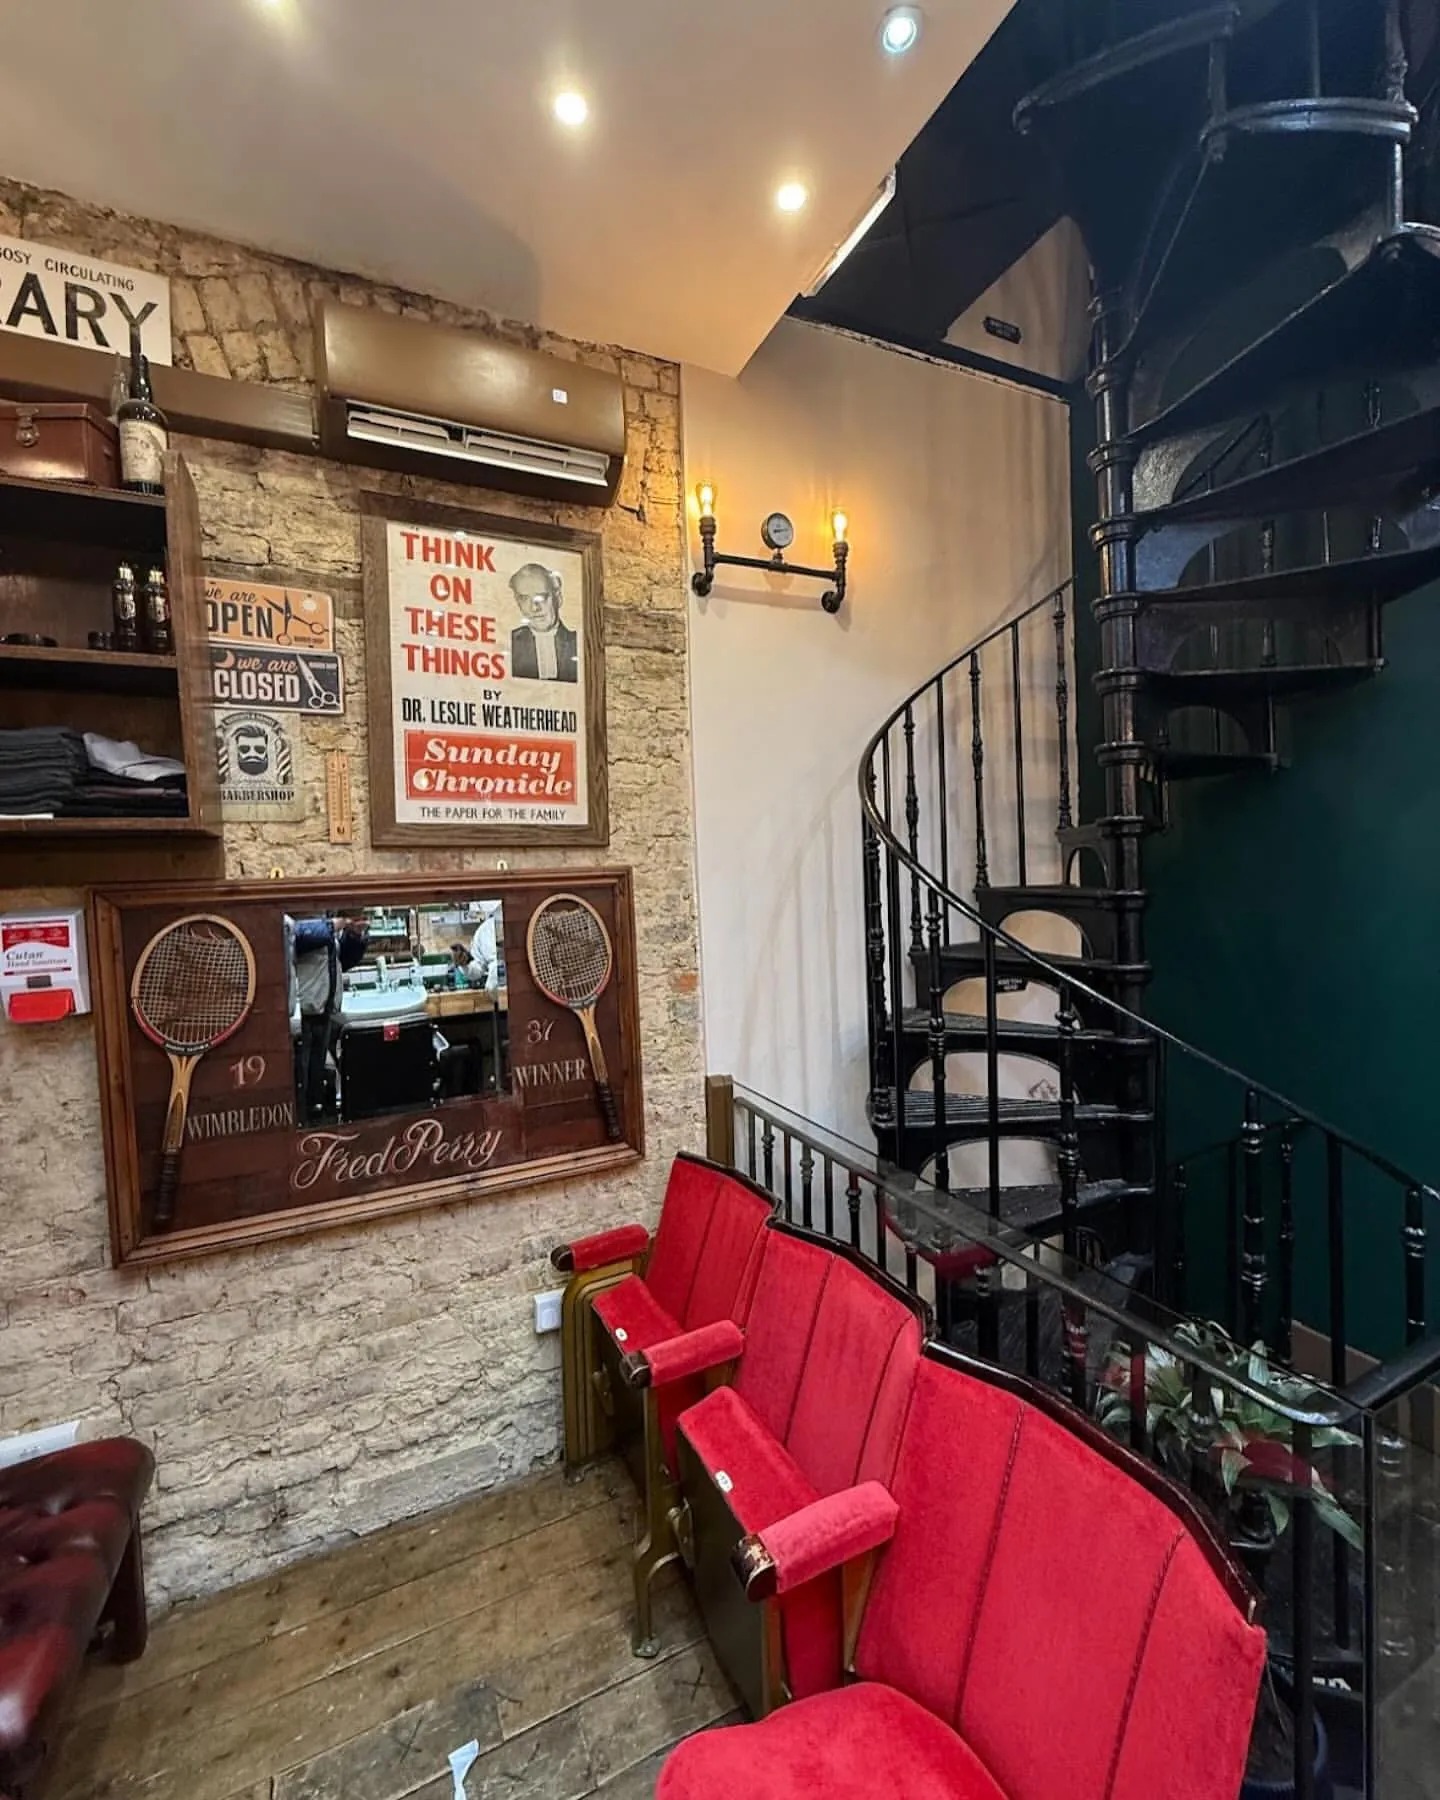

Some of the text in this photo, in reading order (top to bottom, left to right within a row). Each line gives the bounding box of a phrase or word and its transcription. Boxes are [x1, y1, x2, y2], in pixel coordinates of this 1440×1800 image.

[0, 247, 135, 292] OSY CIRCULATING
[0, 271, 158, 352] ARY
[400, 531, 497, 573] THINK
[230, 591, 257, 603] are
[430, 574, 472, 605] ON
[404, 606, 497, 643] THESE
[237, 657, 262, 670] we
[267, 659, 299, 673] are
[401, 643, 506, 680] THINGS
[214, 669, 300, 702] CLOSED
[483, 689, 503, 701] BY
[402, 697, 577, 733] DR. LESLIE WEATHERHEAD
[423, 738, 561, 775] Sunday
[412, 767, 573, 797] Chronicle
[421, 806, 567, 822] THE PAPER FOR THE FAMILY
[229, 1055, 266, 1088] 19
[514, 1058, 587, 1089] WINNER
[186, 1102, 295, 1141] WIMBLEDON
[292, 1118, 503, 1189] Fred Perry
